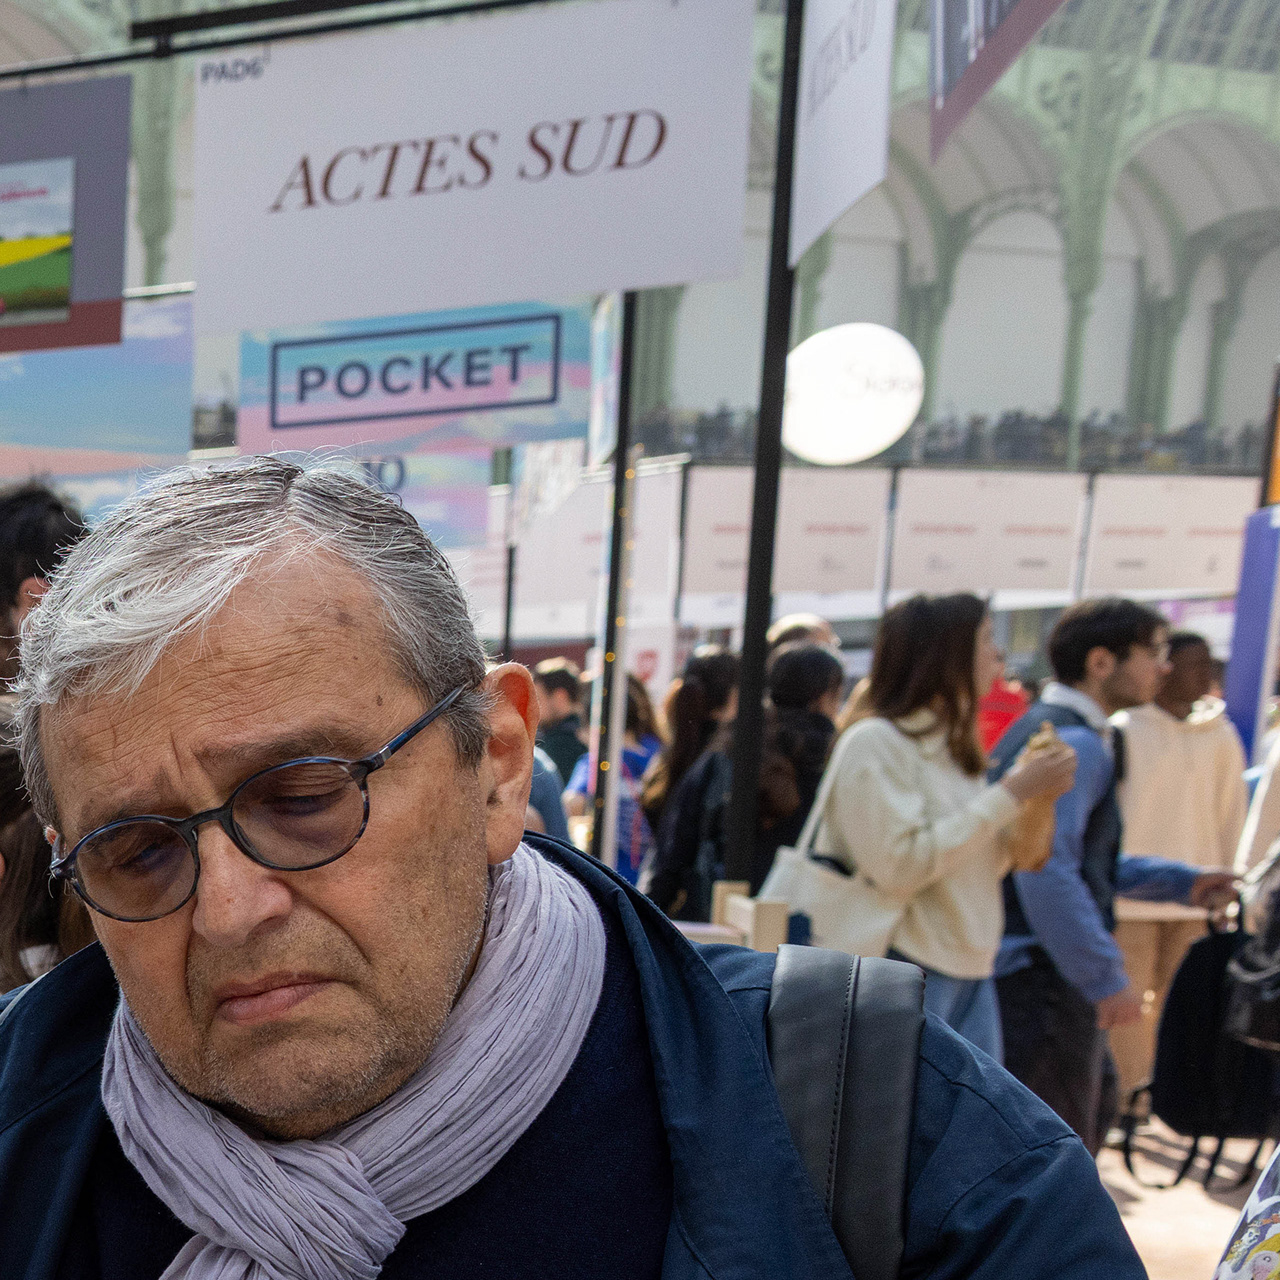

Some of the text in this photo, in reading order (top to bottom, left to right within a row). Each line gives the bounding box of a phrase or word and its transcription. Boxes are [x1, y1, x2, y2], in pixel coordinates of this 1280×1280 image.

[268, 107, 669, 214] ACTES SUD
[296, 344, 533, 404] POCKET
